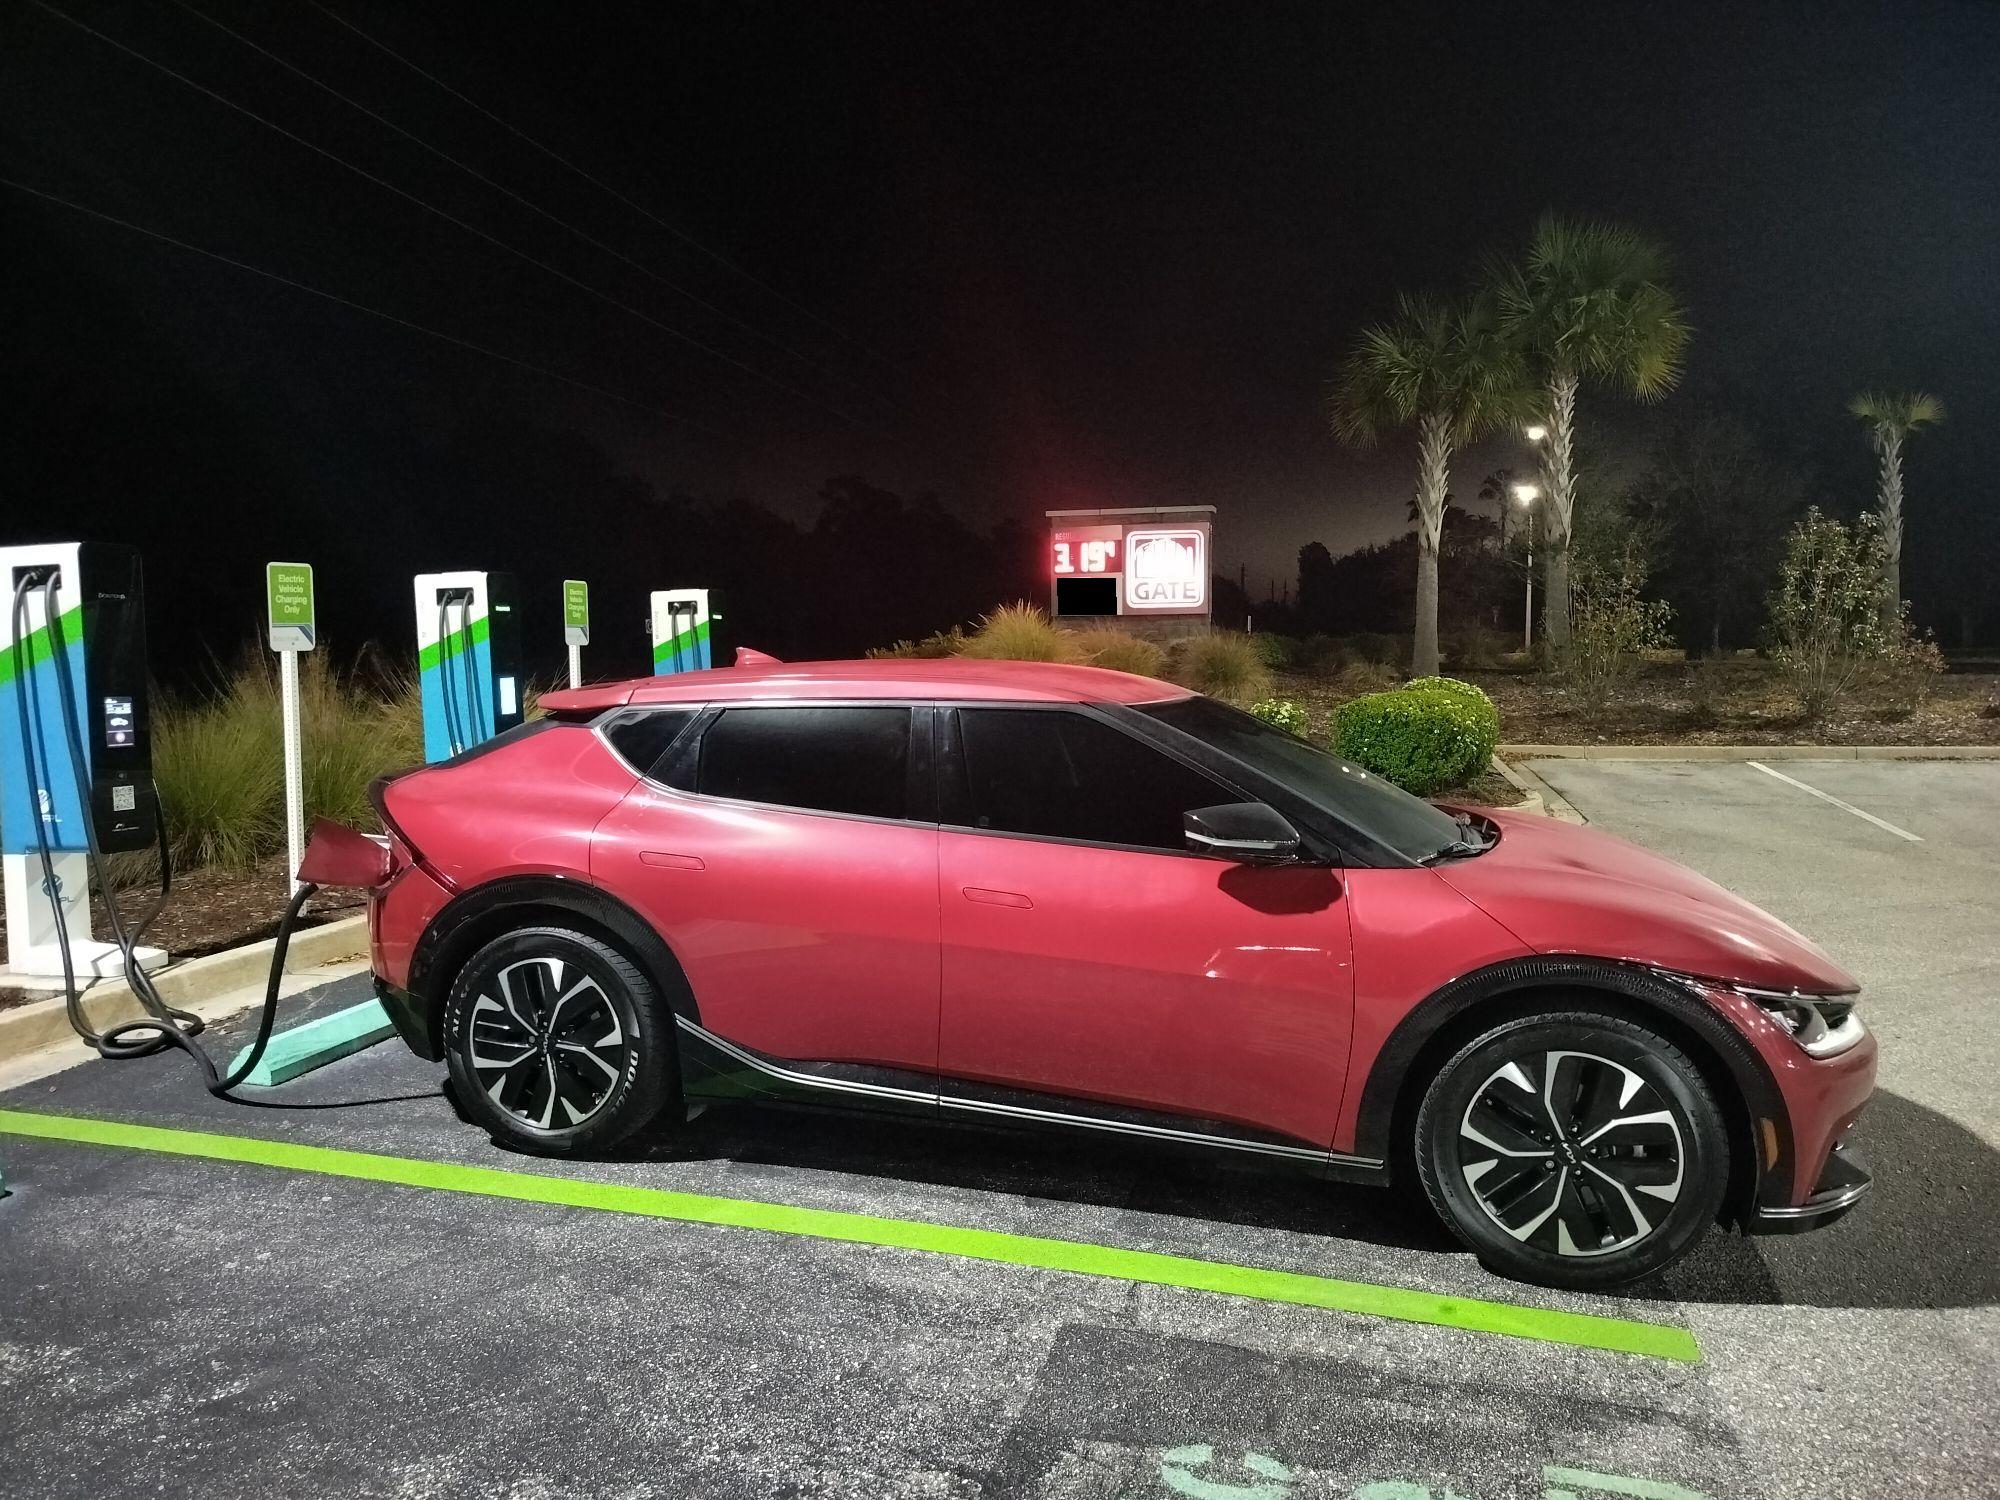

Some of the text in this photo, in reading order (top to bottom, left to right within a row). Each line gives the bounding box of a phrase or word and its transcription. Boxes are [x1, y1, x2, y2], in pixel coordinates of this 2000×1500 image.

[278, 574, 305, 583] Electric
[279, 584, 304, 593] Vehicle
[1134, 582, 1196, 600] GATE
[275, 595, 308, 605] Charging
[284, 605, 300, 614] Only
